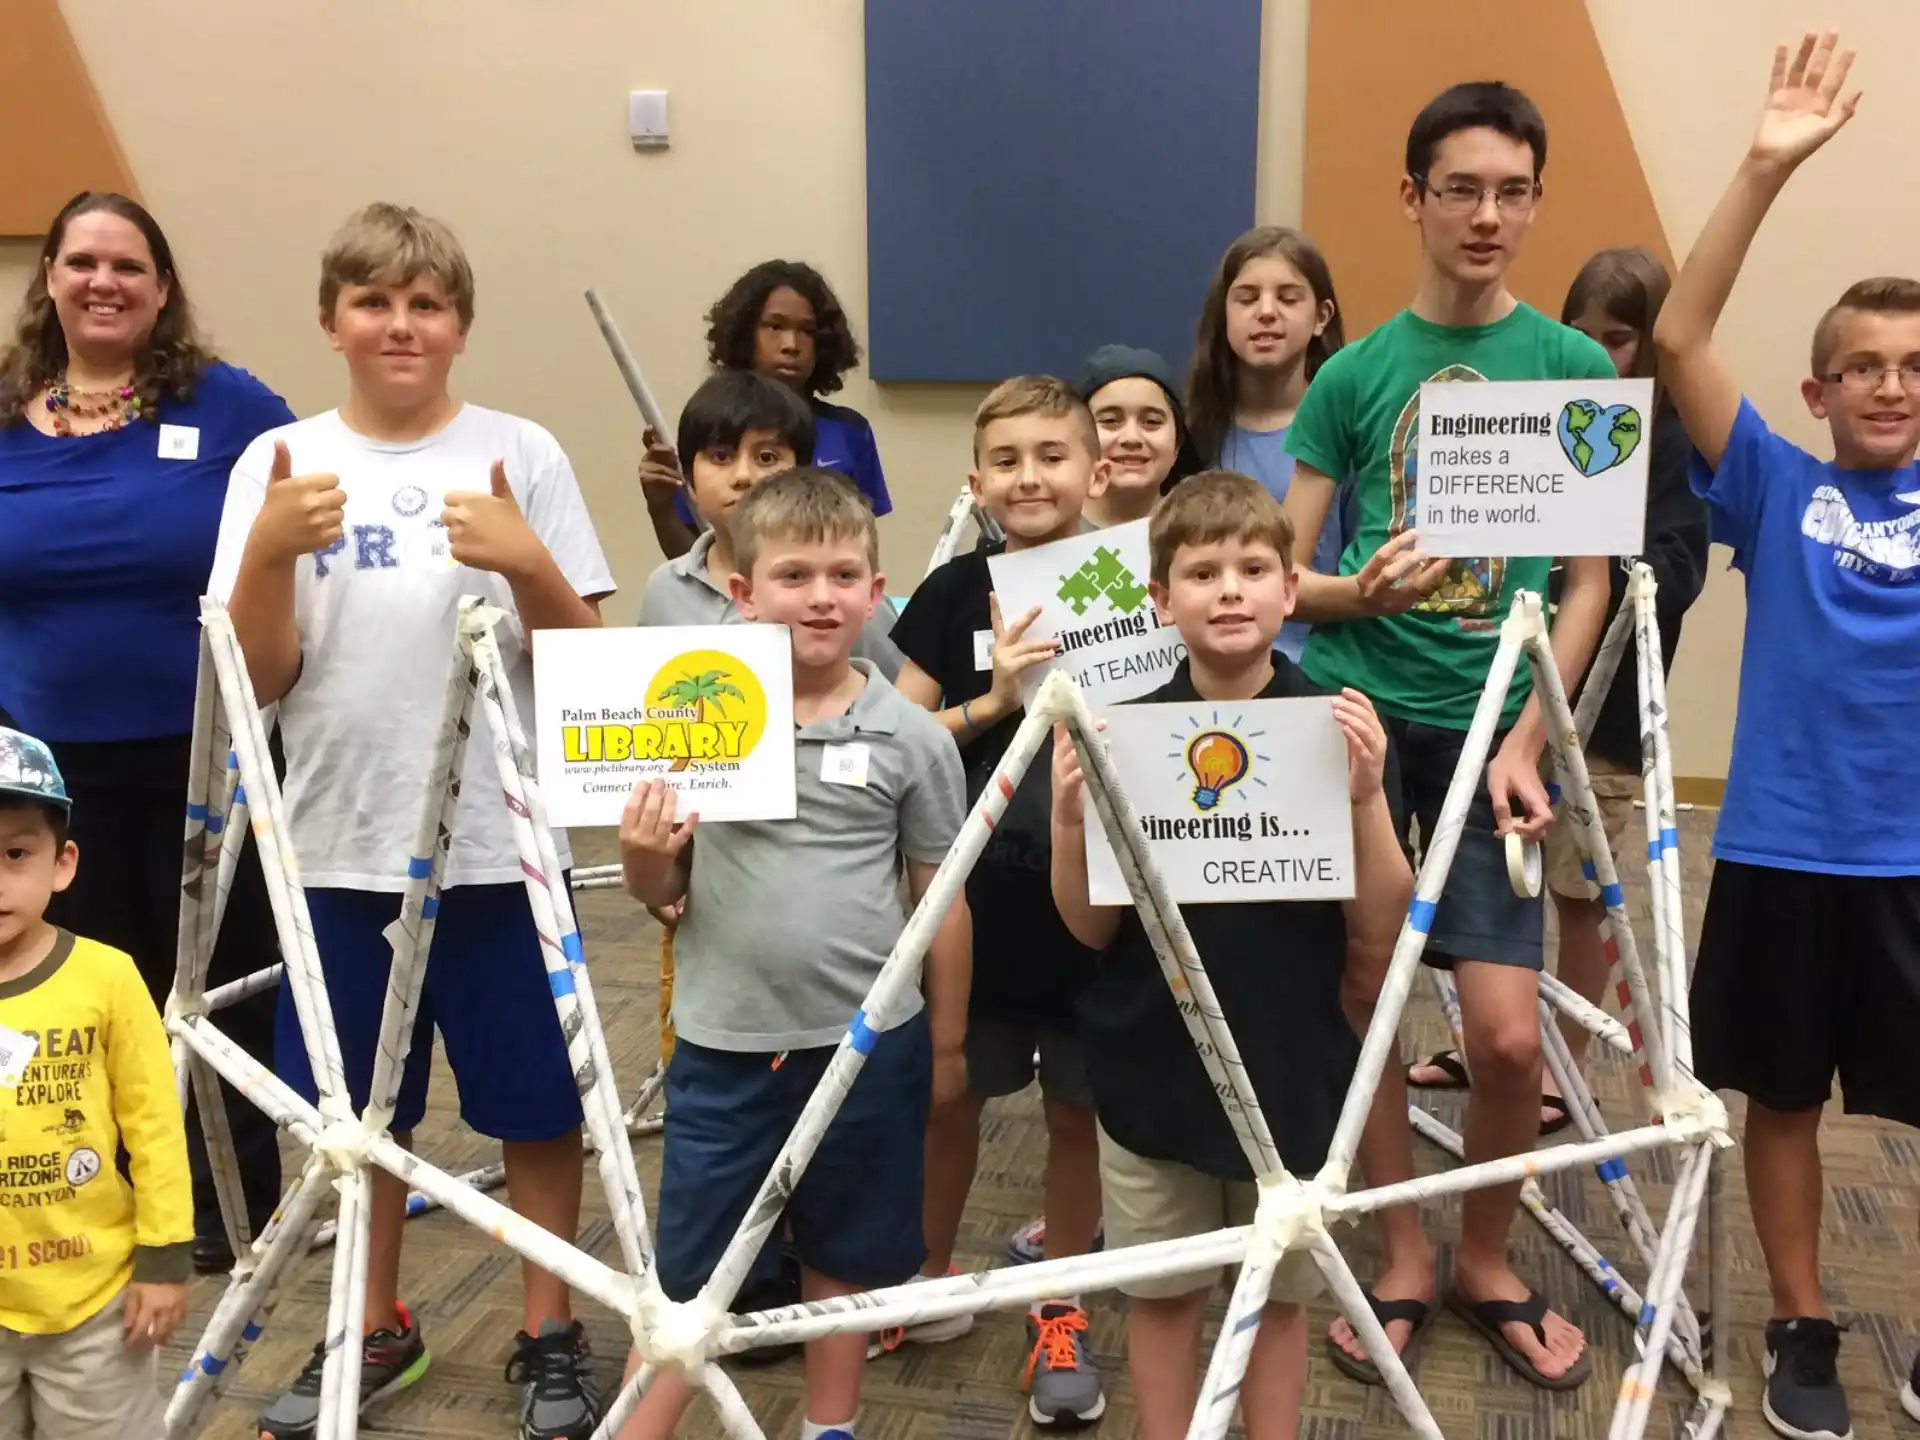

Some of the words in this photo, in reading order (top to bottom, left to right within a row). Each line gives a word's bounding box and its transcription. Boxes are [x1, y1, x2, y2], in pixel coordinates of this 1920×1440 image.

[1431, 412, 1551, 438] Engineering
[1430, 446, 1491, 466] makes
[1499, 450, 1509, 465] a
[1429, 474, 1564, 495] DIFFERENCE
[1428, 505, 1443, 524] in
[1451, 504, 1479, 524] the
[1486, 503, 1540, 524] world.
[1053, 611, 1148, 658] ineering
[1094, 643, 1188, 684] TEAMWO
[562, 708, 597, 722] Palm
[601, 707, 642, 721] Beach
[646, 704, 699, 721] County
[562, 721, 748, 762] LIBRARY
[690, 760, 741, 776] System
[582, 781, 633, 794] Connect
[690, 778, 732, 791] Enrich.
[1140, 813, 1252, 842] ineering
[1203, 857, 1341, 885] CREATIVE.
[22, 1061, 92, 1083] ENTURERS
[16, 1080, 82, 1107] EXPLORE
[7, 1151, 61, 1170] RIDGE
[0, 1167, 62, 1188] RIZONA
